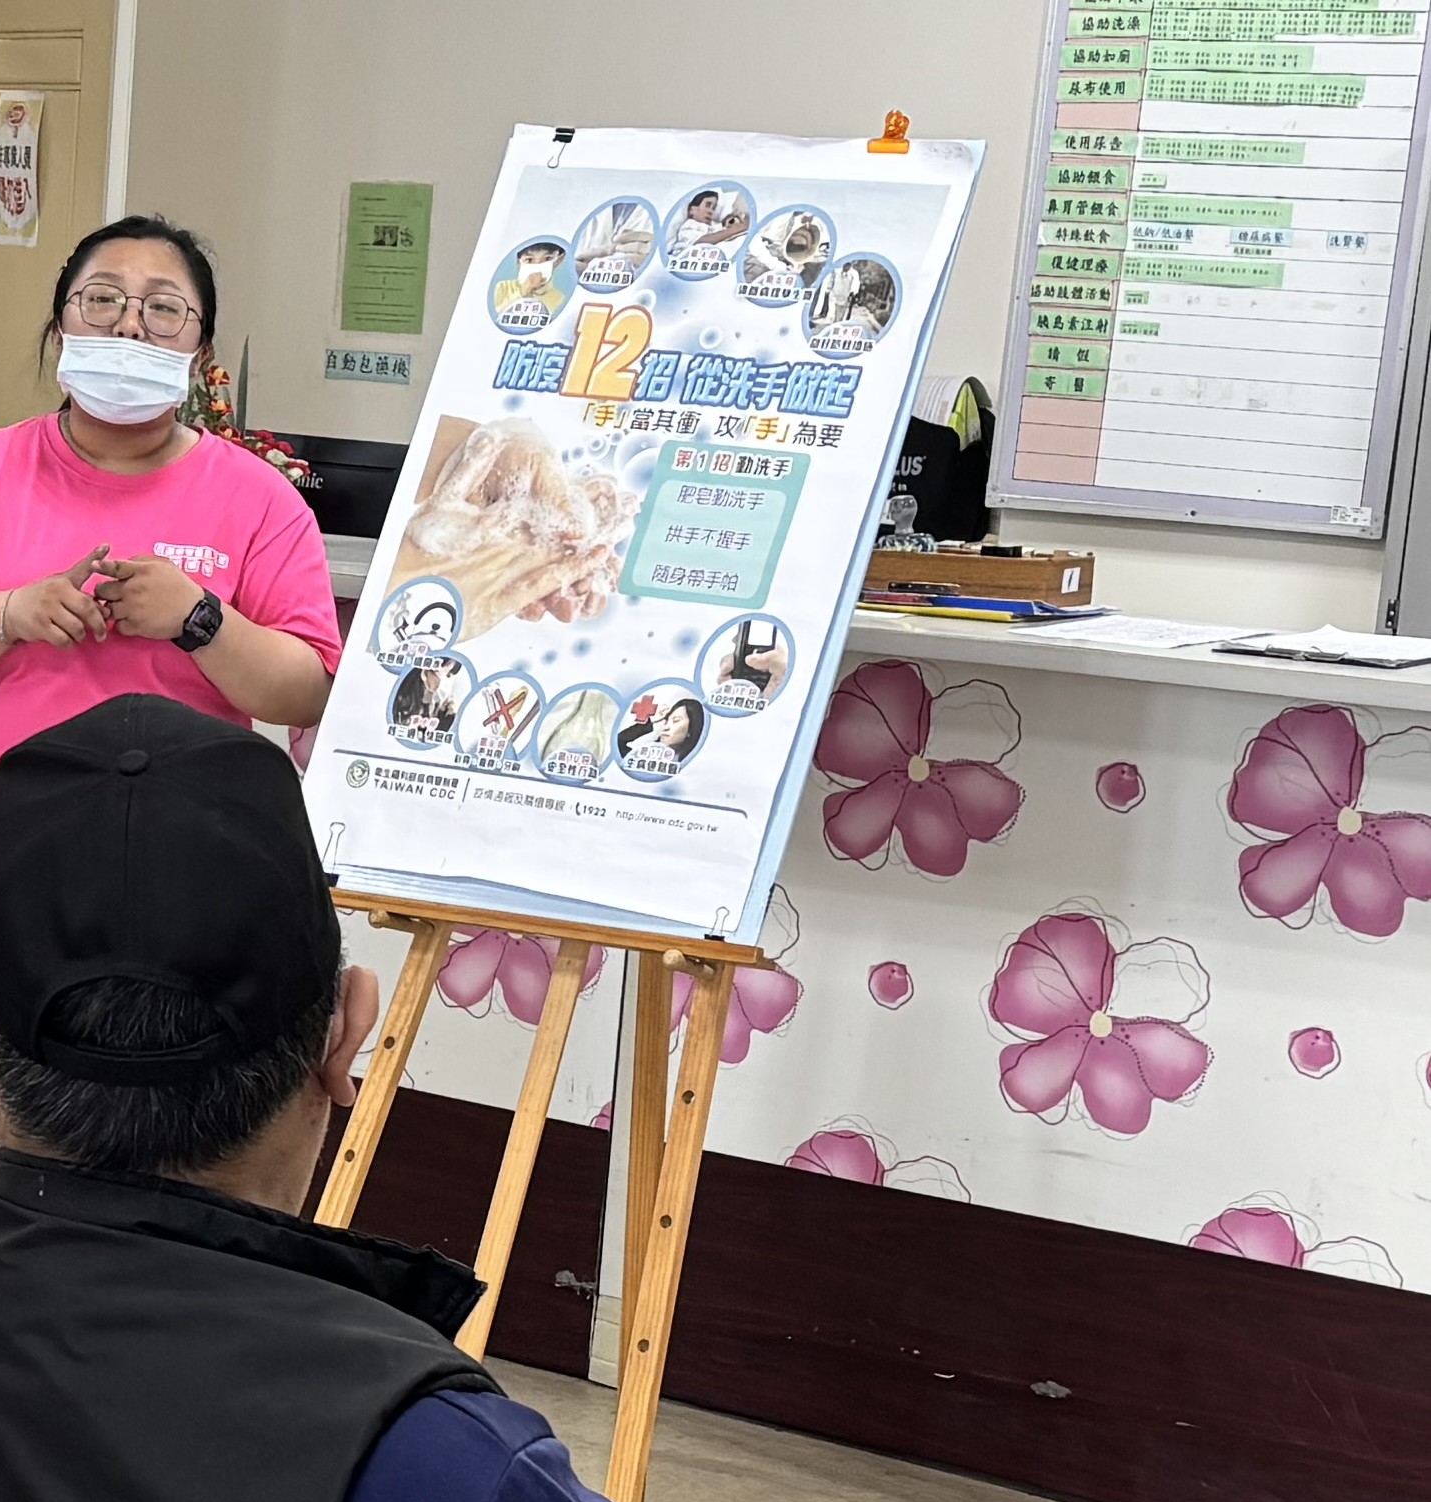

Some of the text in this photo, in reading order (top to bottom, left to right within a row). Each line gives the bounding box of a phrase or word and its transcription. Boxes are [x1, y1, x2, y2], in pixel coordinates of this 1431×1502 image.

[1082, 16, 1140, 31] 協助洗澡
[1068, 80, 1125, 96] 尿布使用
[492, 300, 863, 418] 防疫12招 從洗手做起
[676, 484, 766, 511] 肥皂勤洗手
[664, 524, 752, 551] 拱手不握手
[651, 564, 739, 591] 隨身帶手帕
[374, 778, 456, 800] TAIWAN CDC
